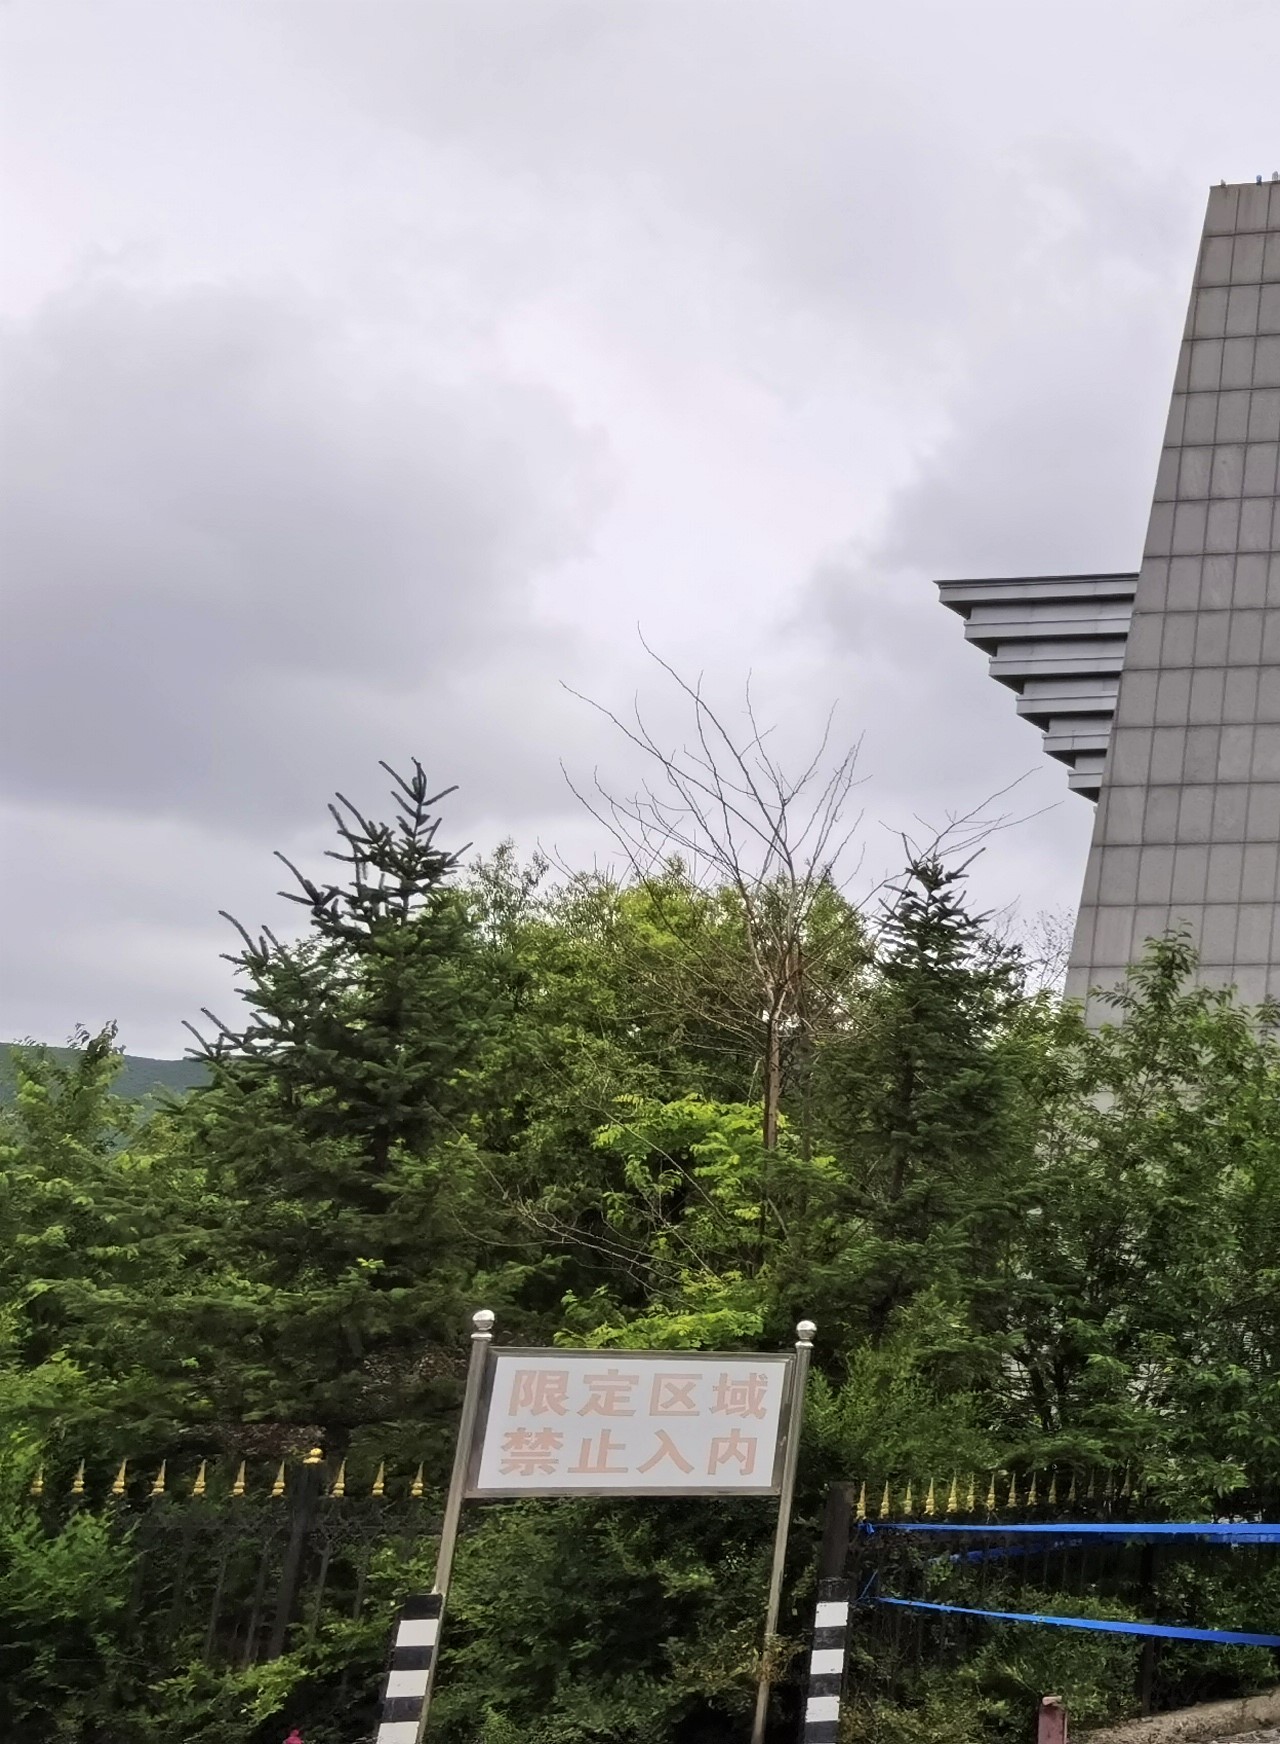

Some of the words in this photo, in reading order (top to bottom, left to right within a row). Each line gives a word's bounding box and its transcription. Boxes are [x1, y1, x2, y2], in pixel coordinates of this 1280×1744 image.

[507, 1368, 768, 1420] 限定区域
[498, 1426, 758, 1478] 禁止入内
